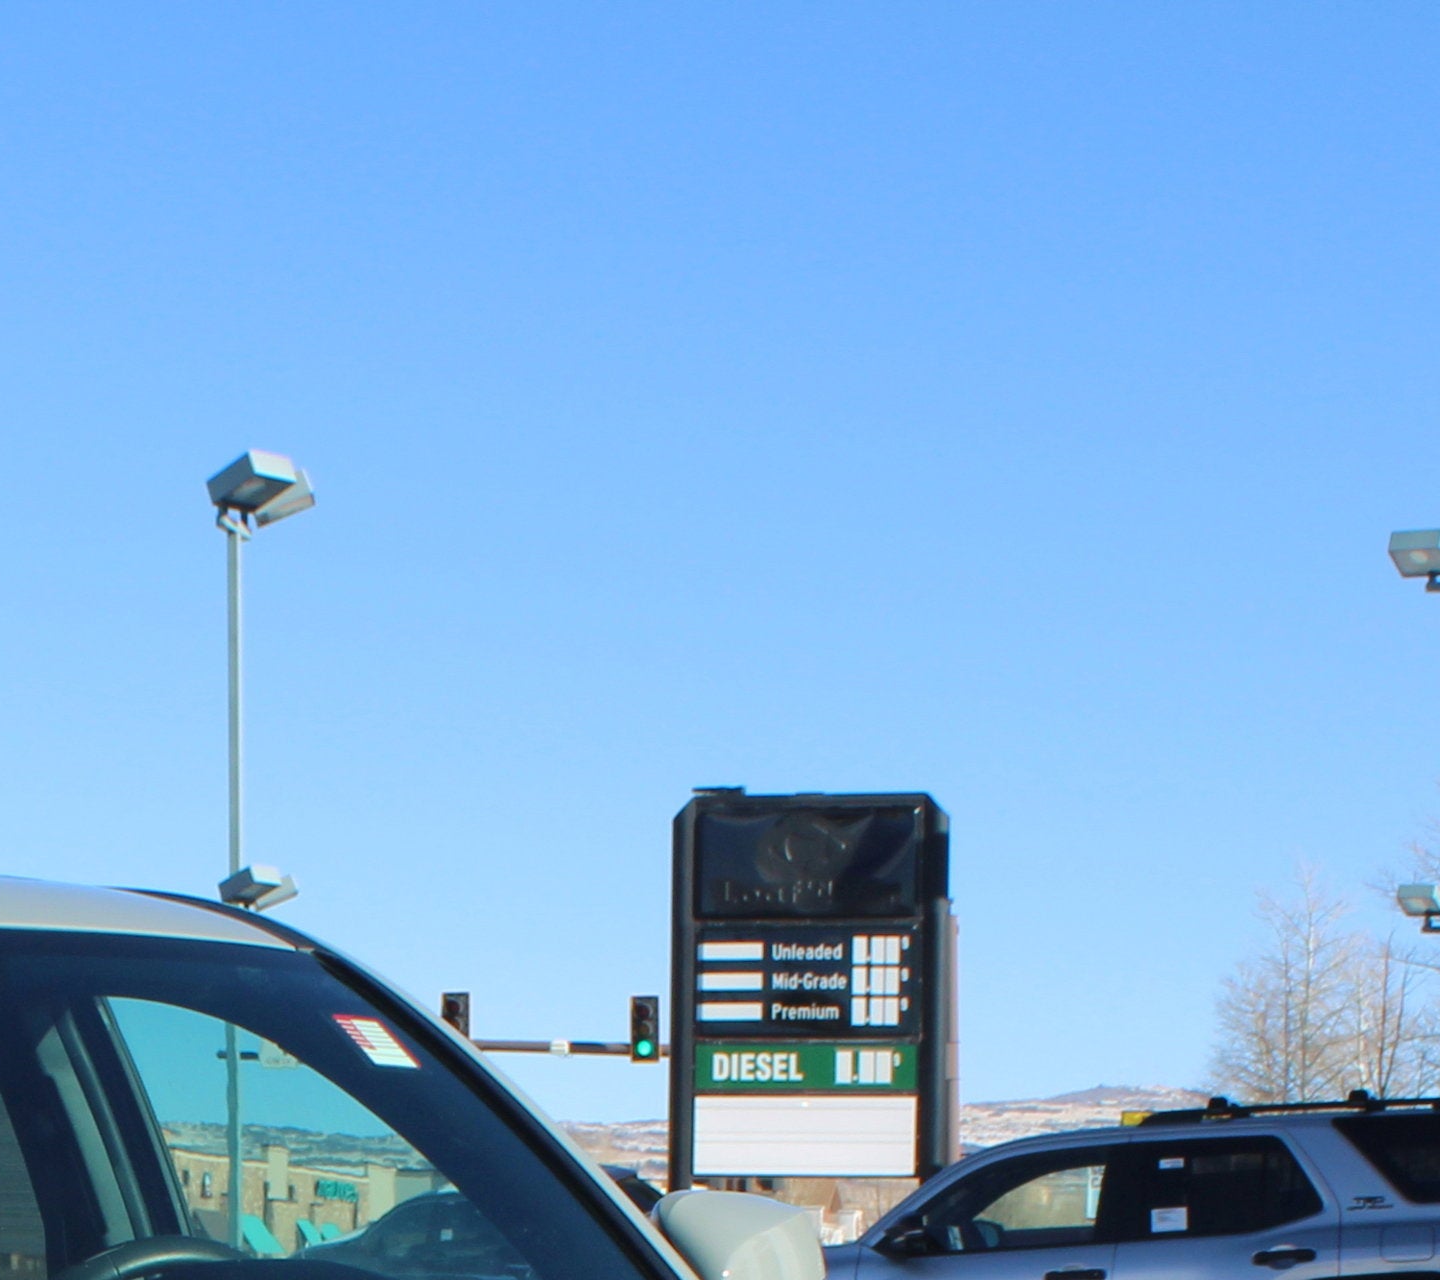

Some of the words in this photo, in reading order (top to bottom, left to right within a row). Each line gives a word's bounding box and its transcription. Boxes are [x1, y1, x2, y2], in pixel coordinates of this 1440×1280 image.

[771, 943, 844, 961] Unleaded
[771, 972, 848, 991] Mid-Grade
[771, 1002, 840, 1021] Premium
[711, 1050, 804, 1082] DIESEL
